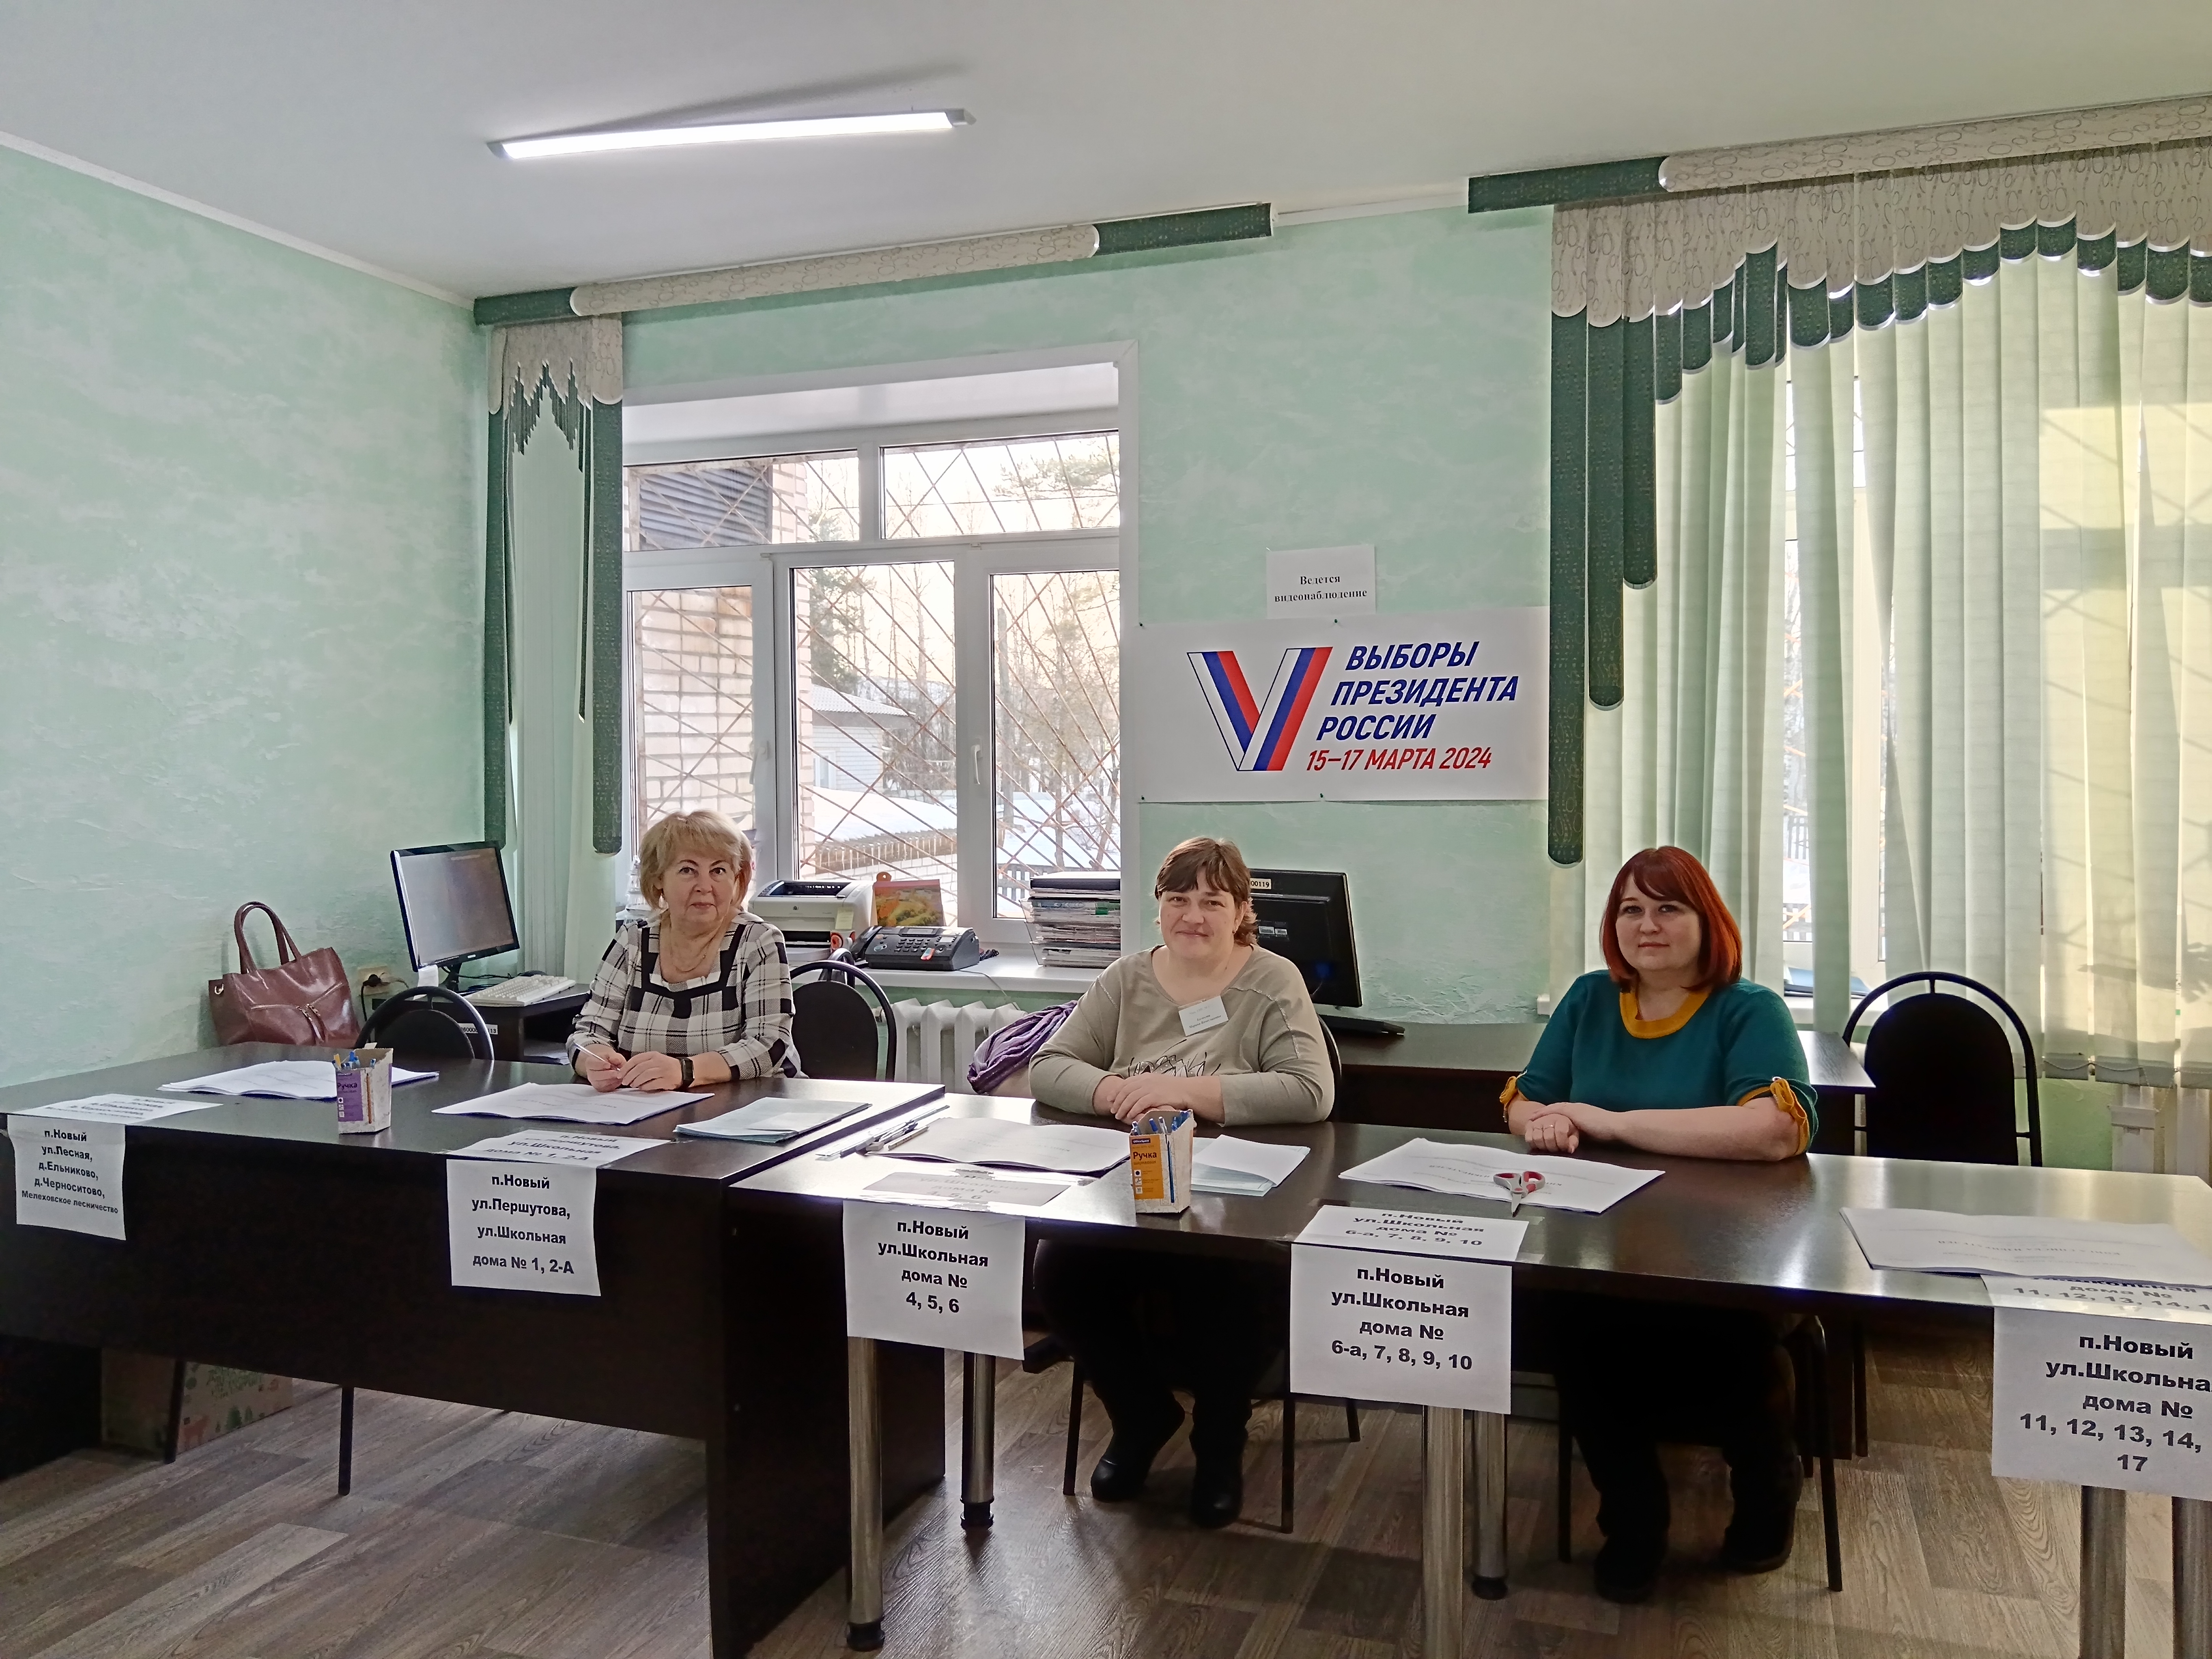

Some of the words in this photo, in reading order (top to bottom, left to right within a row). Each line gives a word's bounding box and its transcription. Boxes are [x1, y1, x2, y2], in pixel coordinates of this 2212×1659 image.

[1300, 574, 1340, 585] Ведется
[1274, 589, 1367, 603] видеонаблюдение
[1345, 641, 1479, 671] ВЫБОРЫ
[1330, 676, 1519, 707] ПРЕЗИДЕНТА
[1316, 714, 1436, 741] РОССИИ
[1365, 748, 1436, 770] МАРТА
[1439, 747, 1491, 769] 2024
[44, 1129, 87, 1142] п.Новый
[42, 1145, 92, 1161] ул.Лесная,
[508, 1141, 602, 1153] ул.Школьная
[1133, 1151, 1157, 1161] Ручка
[39, 1161, 98, 1180] д.Ельниково,
[34, 1177, 105, 1199] д.Черноситово,
[492, 1174, 550, 1189] п.Новый
[22, 1190, 71, 1205] Мелеховское
[73, 1200, 118, 1214] лесничество
[471, 1199, 570, 1219] ул.Першутова,
[1353, 1218, 1484, 1232] ул.Школьная
[1382, 1213, 1463, 1223] п.Новый
[477, 1226, 566, 1244] ул.Школьная
[897, 1220, 969, 1239] п.Новый
[878, 1242, 988, 1267] ул.Школьная
[473, 1255, 506, 1267] дома
[511, 1257, 527, 1269] №
[532, 1258, 545, 1274] 1,
[550, 1260, 574, 1274] 2-А
[902, 1269, 942, 1285] дома
[948, 1273, 967, 1288] №
[1357, 1267, 1444, 1289] п.Новый
[2013, 1288, 2050, 1297] 11,
[2059, 1292, 2096, 1301] 12,
[2105, 1296, 2142, 1305] 13,
[2152, 1300, 2189, 1309] 14,
[2070, 1286, 2133, 1294] дома
[906, 1292, 921, 1310] 4,
[928, 1295, 943, 1314] 5,
[949, 1298, 959, 1313] 6
[1331, 1291, 1468, 1317] ул.Школьная
[1360, 1321, 1412, 1337] дома
[1420, 1324, 1444, 1340] №
[1332, 1340, 1367, 1360] 6-а,
[1374, 1345, 1391, 1363] 7,
[1399, 1348, 1415, 1366] 8,
[1423, 1351, 1441, 1369] 9,
[1449, 1354, 1472, 1370] 10
[2079, 1334, 2193, 1360] п.Новый
[2046, 1362, 2212, 1392] ул.Школьна
[2083, 1395, 2151, 1414] дома
[2161, 1400, 2193, 1419] №
[2020, 1413, 2057, 1435] 11,
[2067, 1418, 2104, 1441] 12,
[2114, 1424, 2152, 1447] 13,
[2162, 1430, 2201, 1453] 14,
[2117, 1454, 2148, 1472] 17
